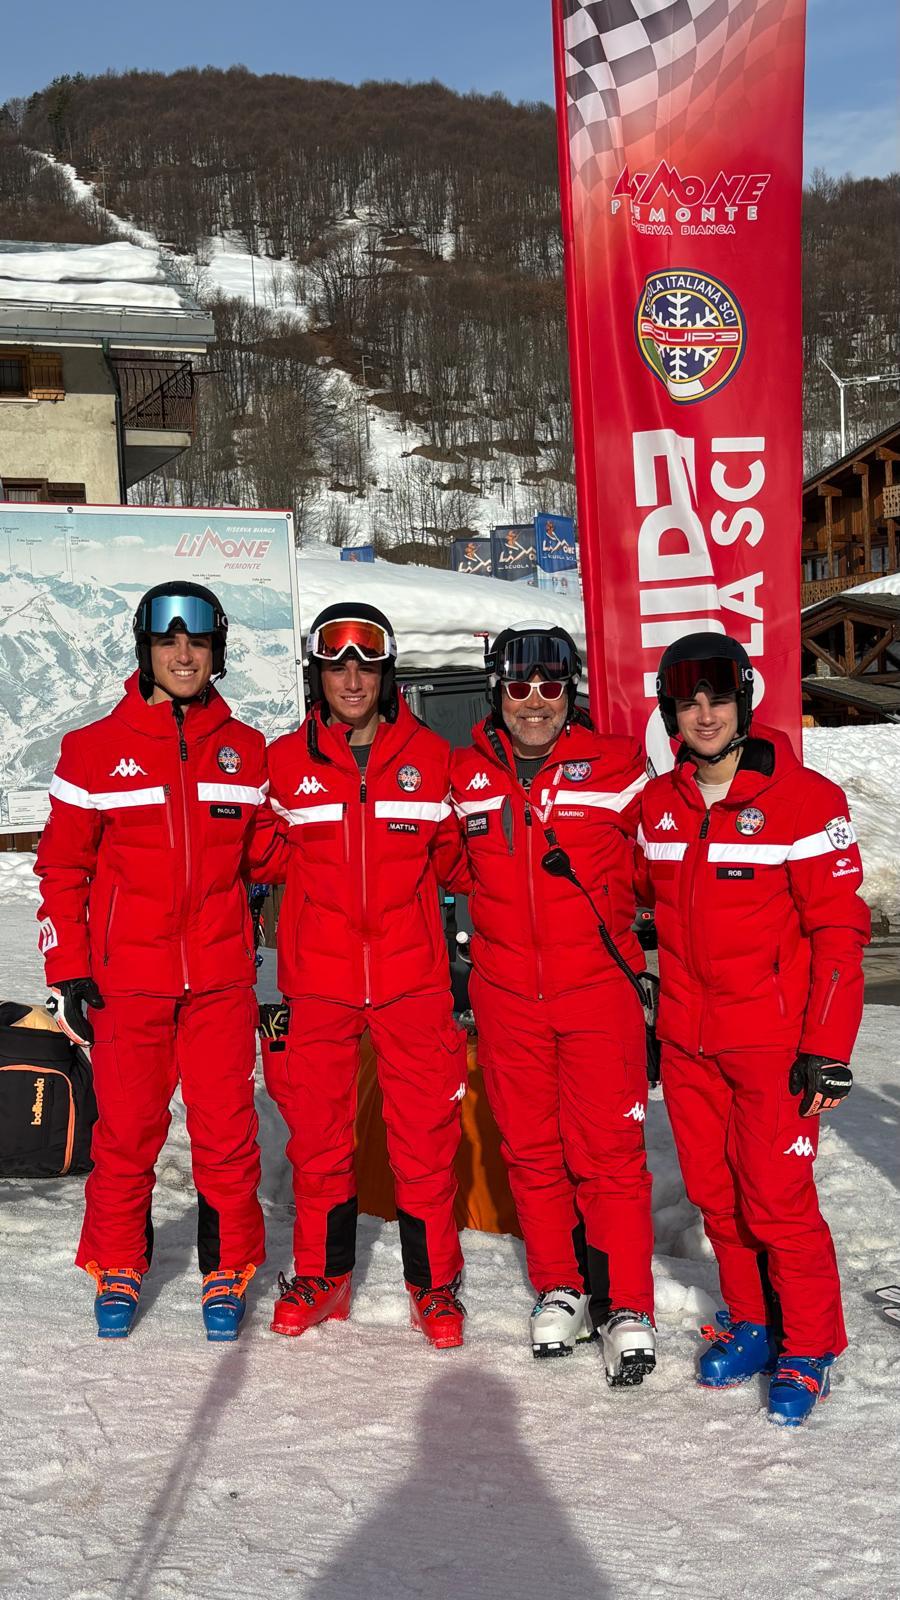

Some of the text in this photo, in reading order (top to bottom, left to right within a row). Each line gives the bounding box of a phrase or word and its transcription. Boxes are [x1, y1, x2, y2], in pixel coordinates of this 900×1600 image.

[681, 224, 736, 236] BIANCA
[666, 276, 722, 304] ITALIANA
[719, 301, 737, 323] SCI
[710, 436, 766, 547] SCI
[223, 562, 261, 570] PIEMONTE
[217, 807, 236, 815] PAOLO
[389, 823, 416, 831] MATTIA
[728, 869, 743, 877] ROB
